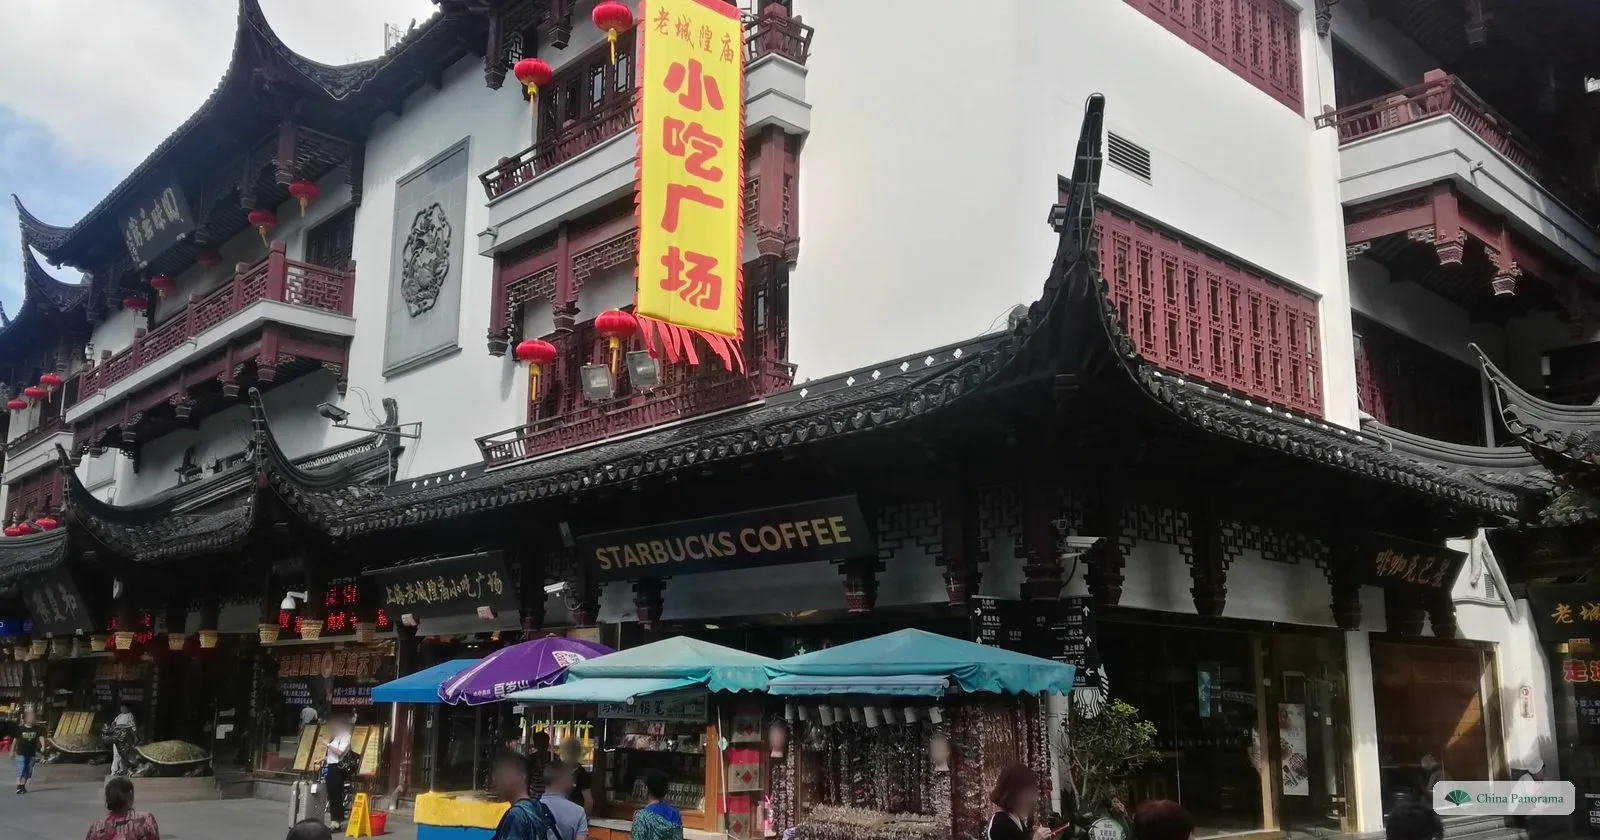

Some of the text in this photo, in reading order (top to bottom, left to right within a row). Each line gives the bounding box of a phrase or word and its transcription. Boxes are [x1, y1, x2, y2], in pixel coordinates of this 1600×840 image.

[654, 6, 734, 63] 老城隍庙
[660, 58, 723, 310] 小吃广场
[596, 516, 851, 570] STARBUCKS COFFEE
[386, 571, 502, 605] 上海老城隍庙小吃广场
[495, 680, 529, 698] 百岁山
